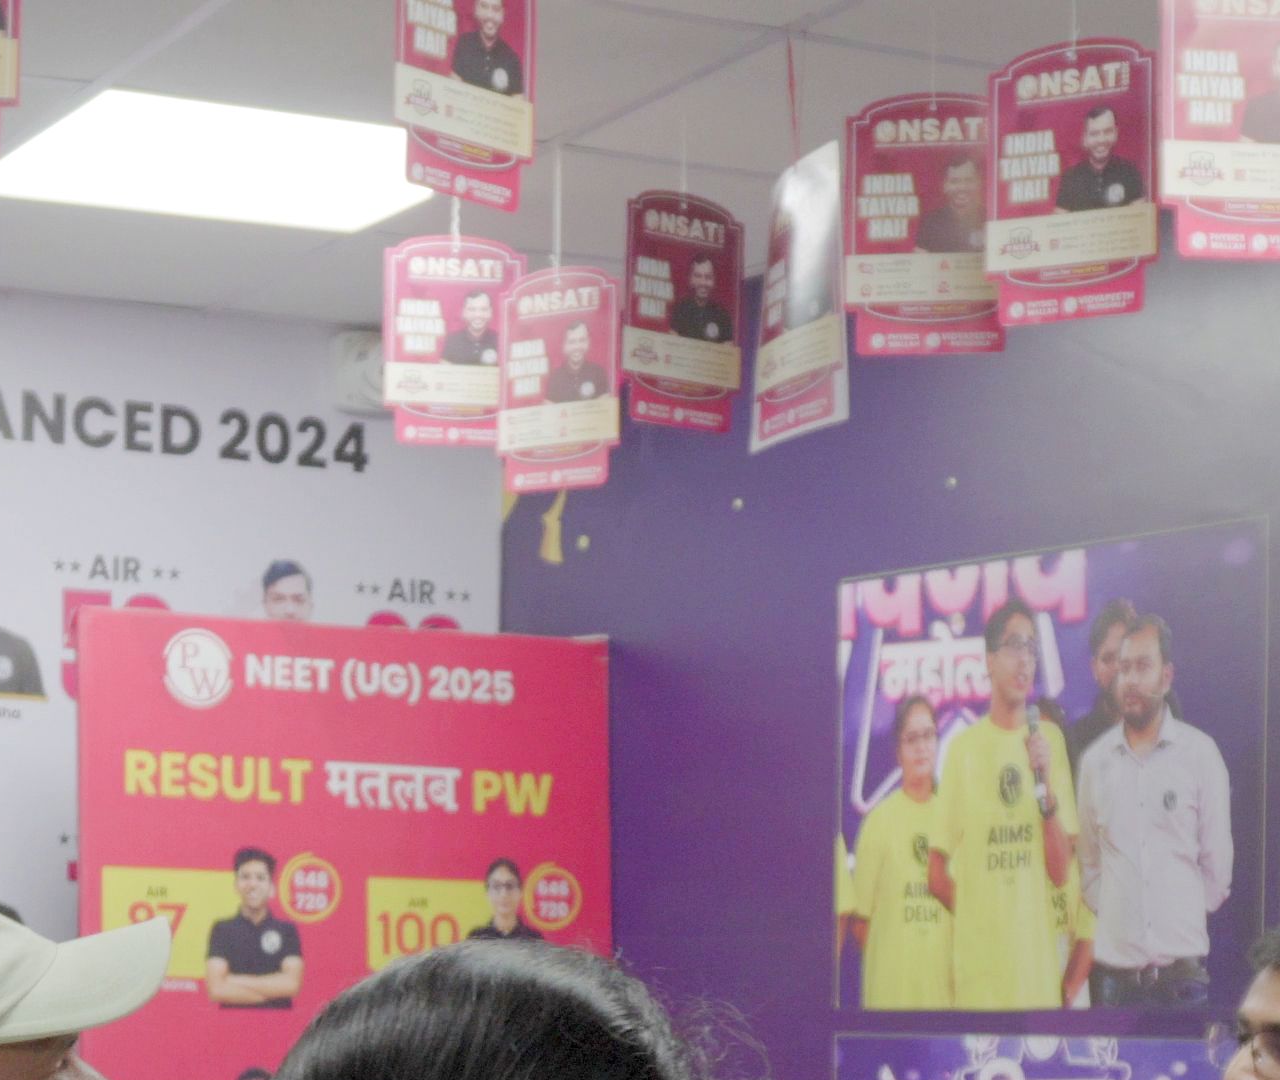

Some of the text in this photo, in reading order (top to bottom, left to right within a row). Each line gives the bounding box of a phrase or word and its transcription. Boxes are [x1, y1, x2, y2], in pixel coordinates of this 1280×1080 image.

[220, 408, 372, 474] 2024
[88, 552, 142, 584] AIR
[387, 578, 437, 605] AIR
[244, 653, 515, 705] NEET (UG) 2025
[124, 749, 555, 816] RESULT मतलब PW
[987, 824, 1033, 846] AIIMS
[987, 851, 1032, 872] DELHI
[146, 885, 169, 899] AIR
[376, 912, 461, 956] 100
